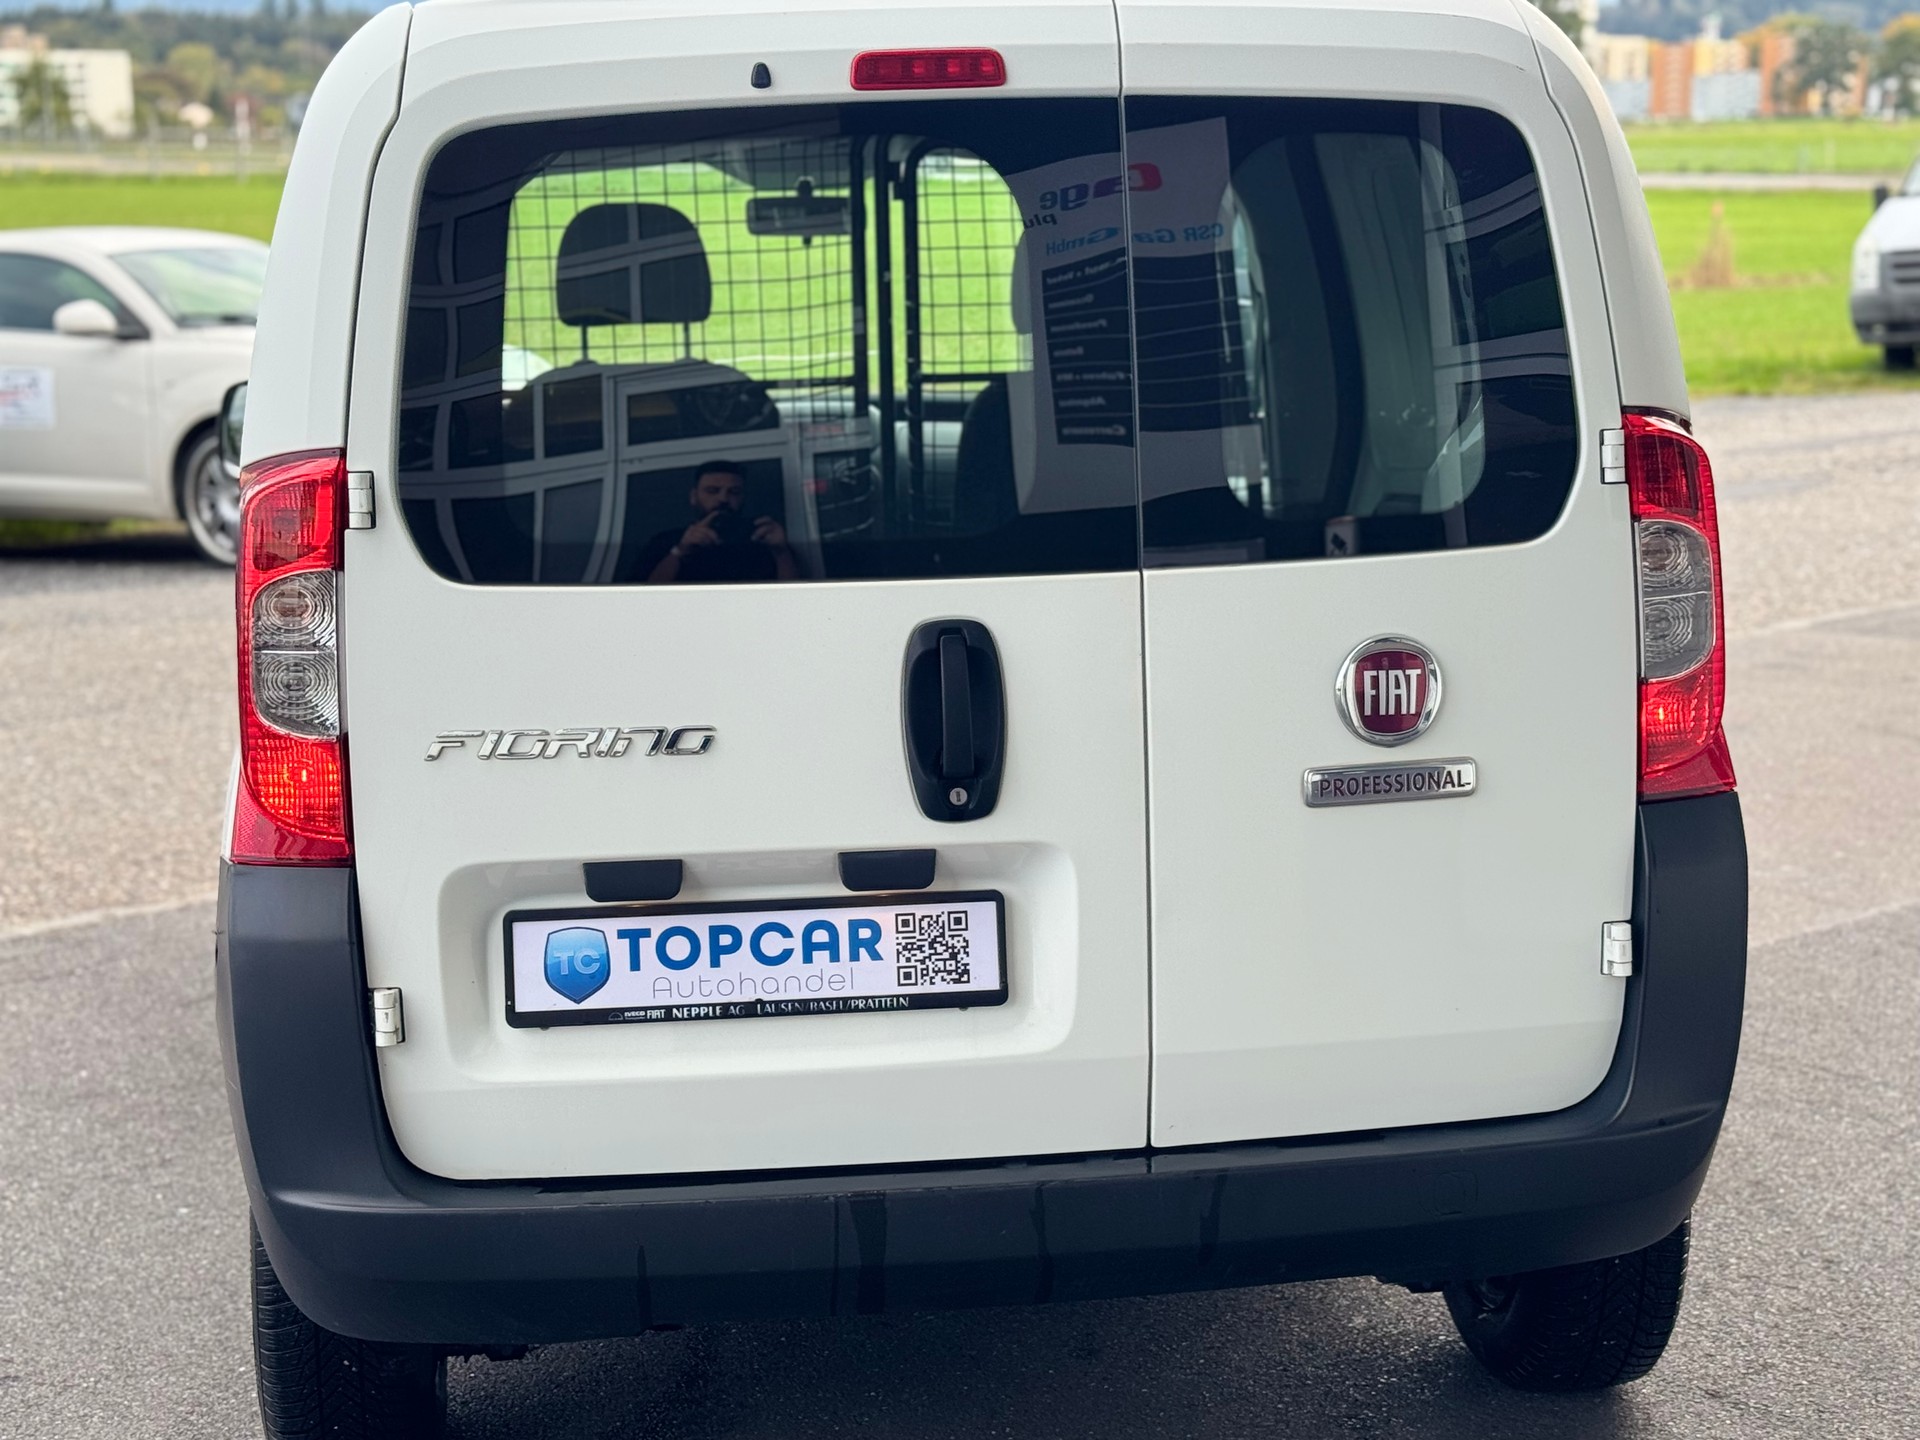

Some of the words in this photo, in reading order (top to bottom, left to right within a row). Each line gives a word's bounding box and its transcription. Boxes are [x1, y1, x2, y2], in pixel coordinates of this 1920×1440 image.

[1363, 668, 1421, 716] FIAT
[423, 724, 717, 762] FIORINO
[1319, 769, 1471, 798] PROFESSIONAL
[553, 947, 600, 976] TC
[616, 918, 884, 972] TOPCAR
[652, 966, 855, 999] Autohandel
[646, 1009, 666, 1020] FIAT
[672, 1005, 723, 1019] NEPPLE
[727, 1004, 746, 1017] AG
